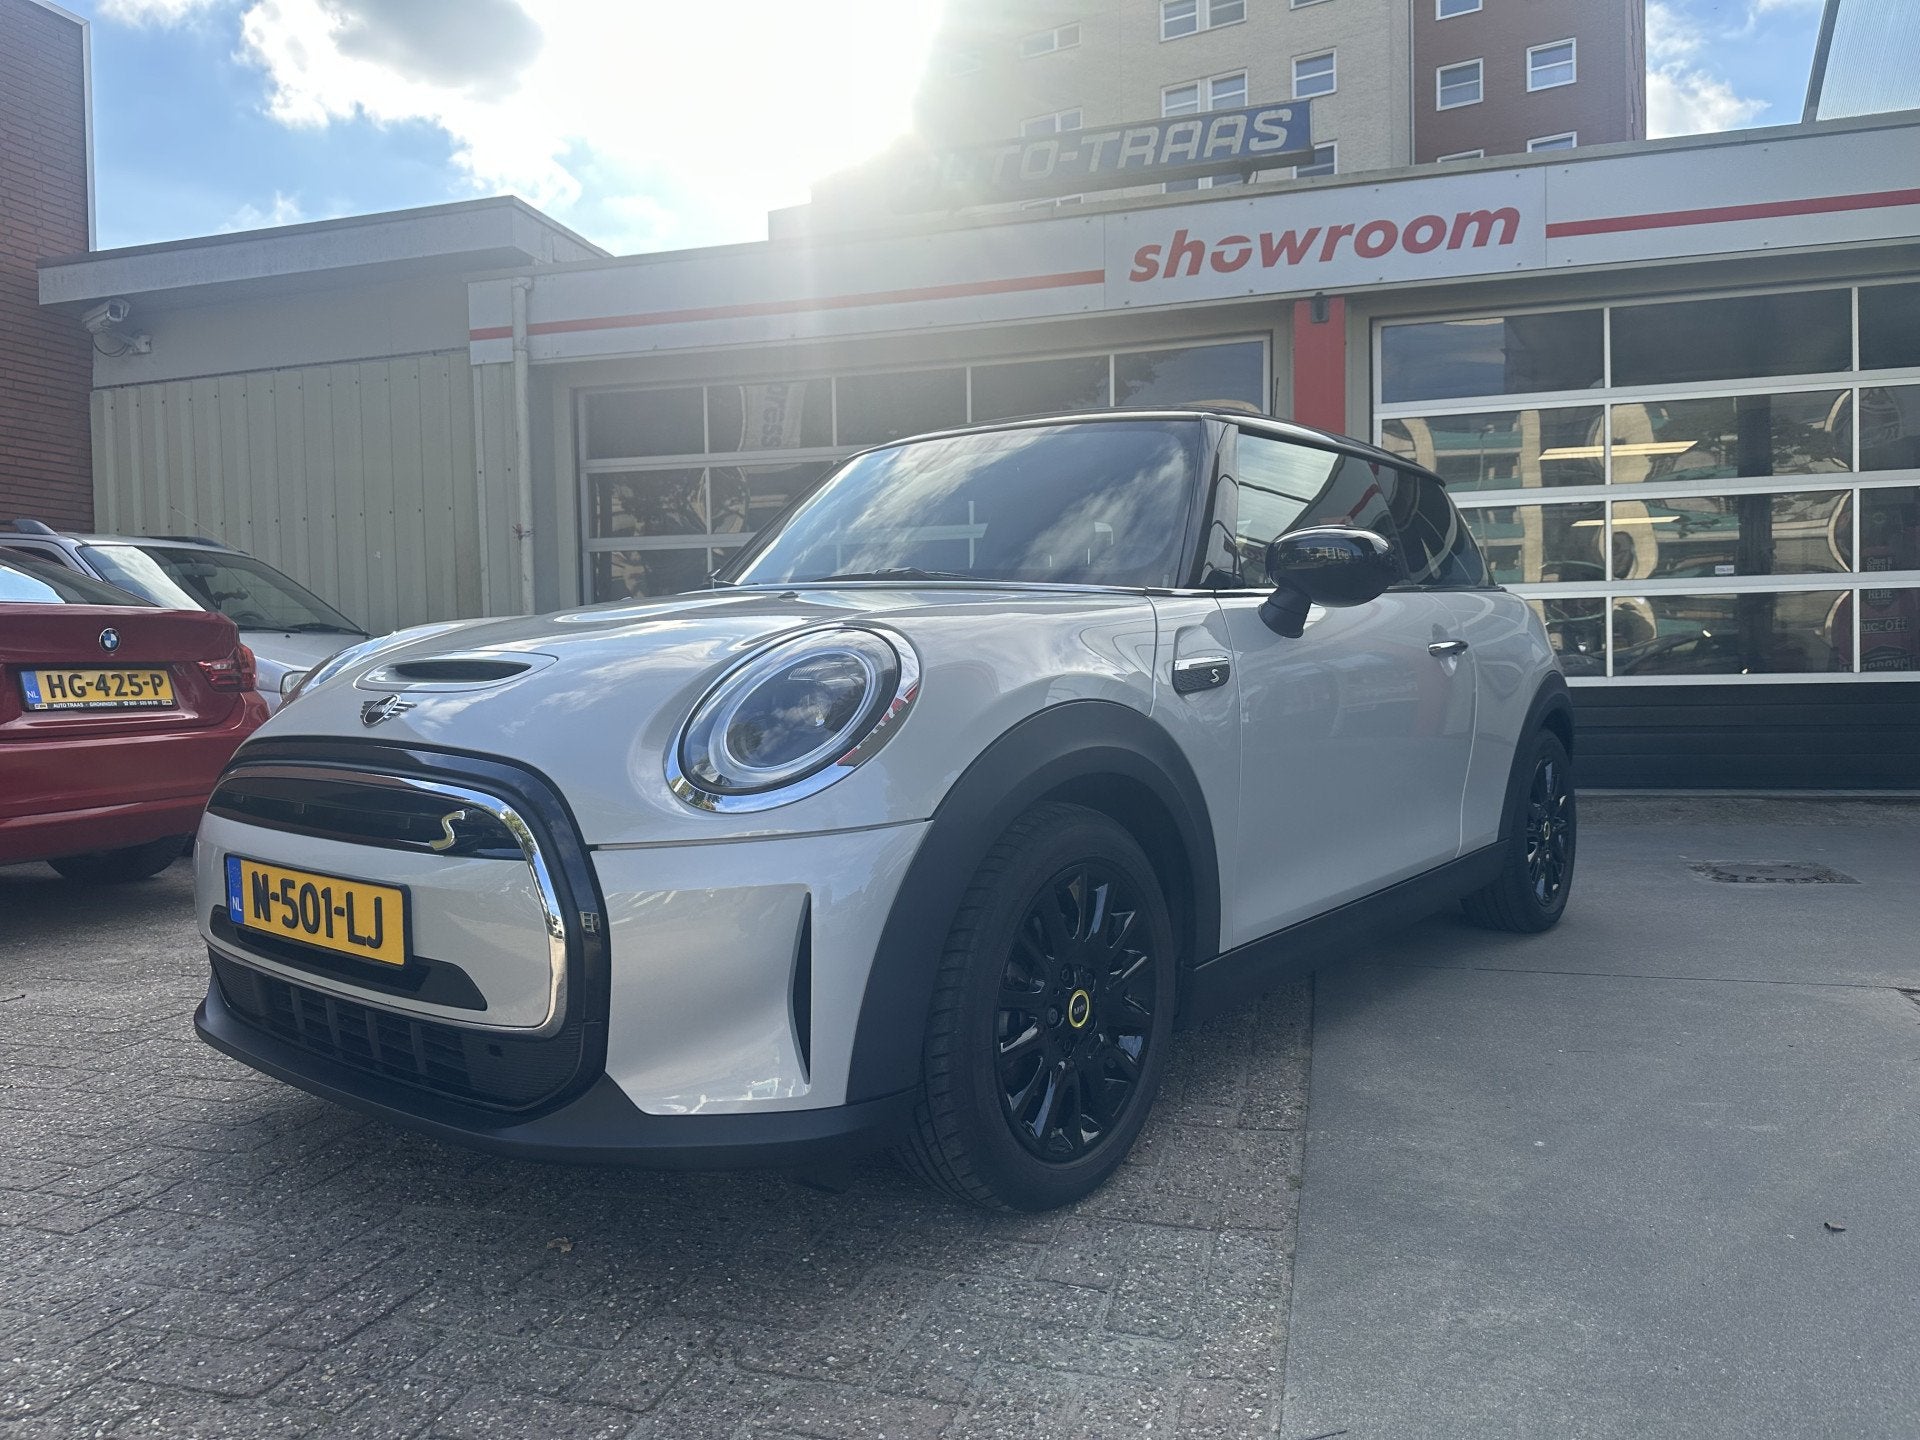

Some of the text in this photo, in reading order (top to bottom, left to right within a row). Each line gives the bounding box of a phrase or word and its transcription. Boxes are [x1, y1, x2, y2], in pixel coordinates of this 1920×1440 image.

[906, 107, 1292, 194] UTO-TRAAS
[1129, 205, 1520, 283] showroom
[46, 673, 164, 698] HG-425-P
[1210, 668, 1220, 683] S
[27, 690, 39, 699] NL
[429, 810, 466, 851] S
[232, 896, 242, 913] NL
[251, 871, 383, 950] N-501-LJ
